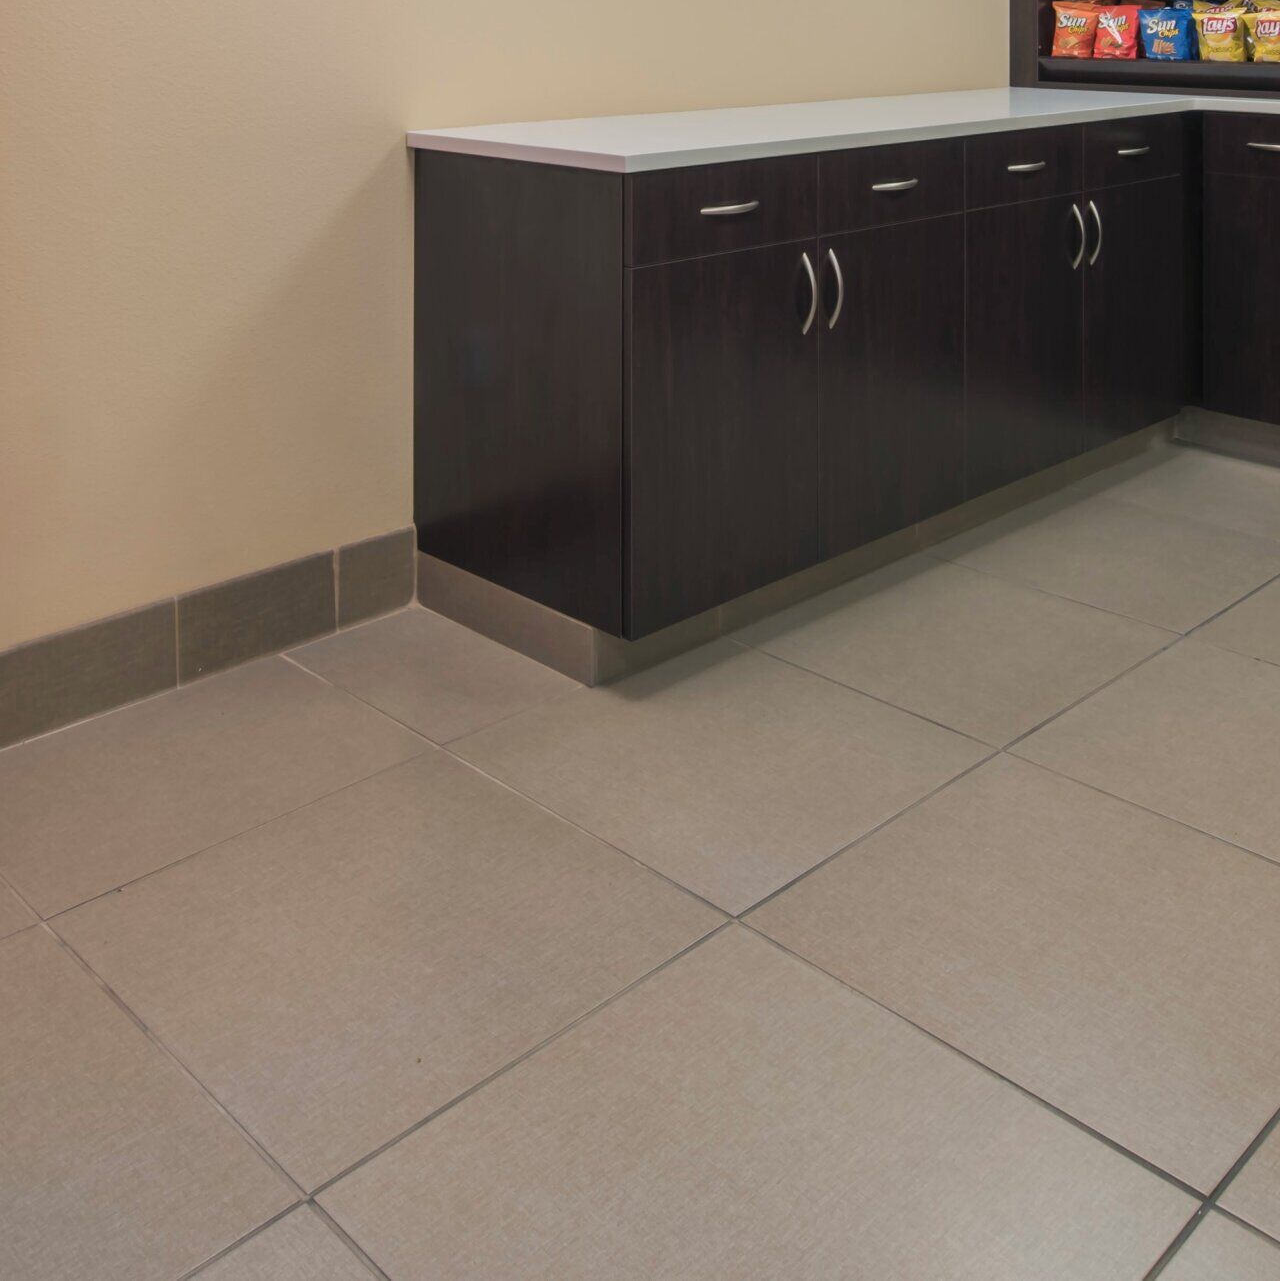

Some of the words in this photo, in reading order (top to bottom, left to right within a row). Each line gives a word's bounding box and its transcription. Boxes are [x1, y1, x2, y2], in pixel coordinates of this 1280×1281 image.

[1057, 14, 1087, 28] Sun
[1098, 12, 1126, 28] Sun
[1146, 19, 1176, 35] Sun
[1203, 17, 1235, 35] Lay's
[1158, 28, 1180, 38] Chips
